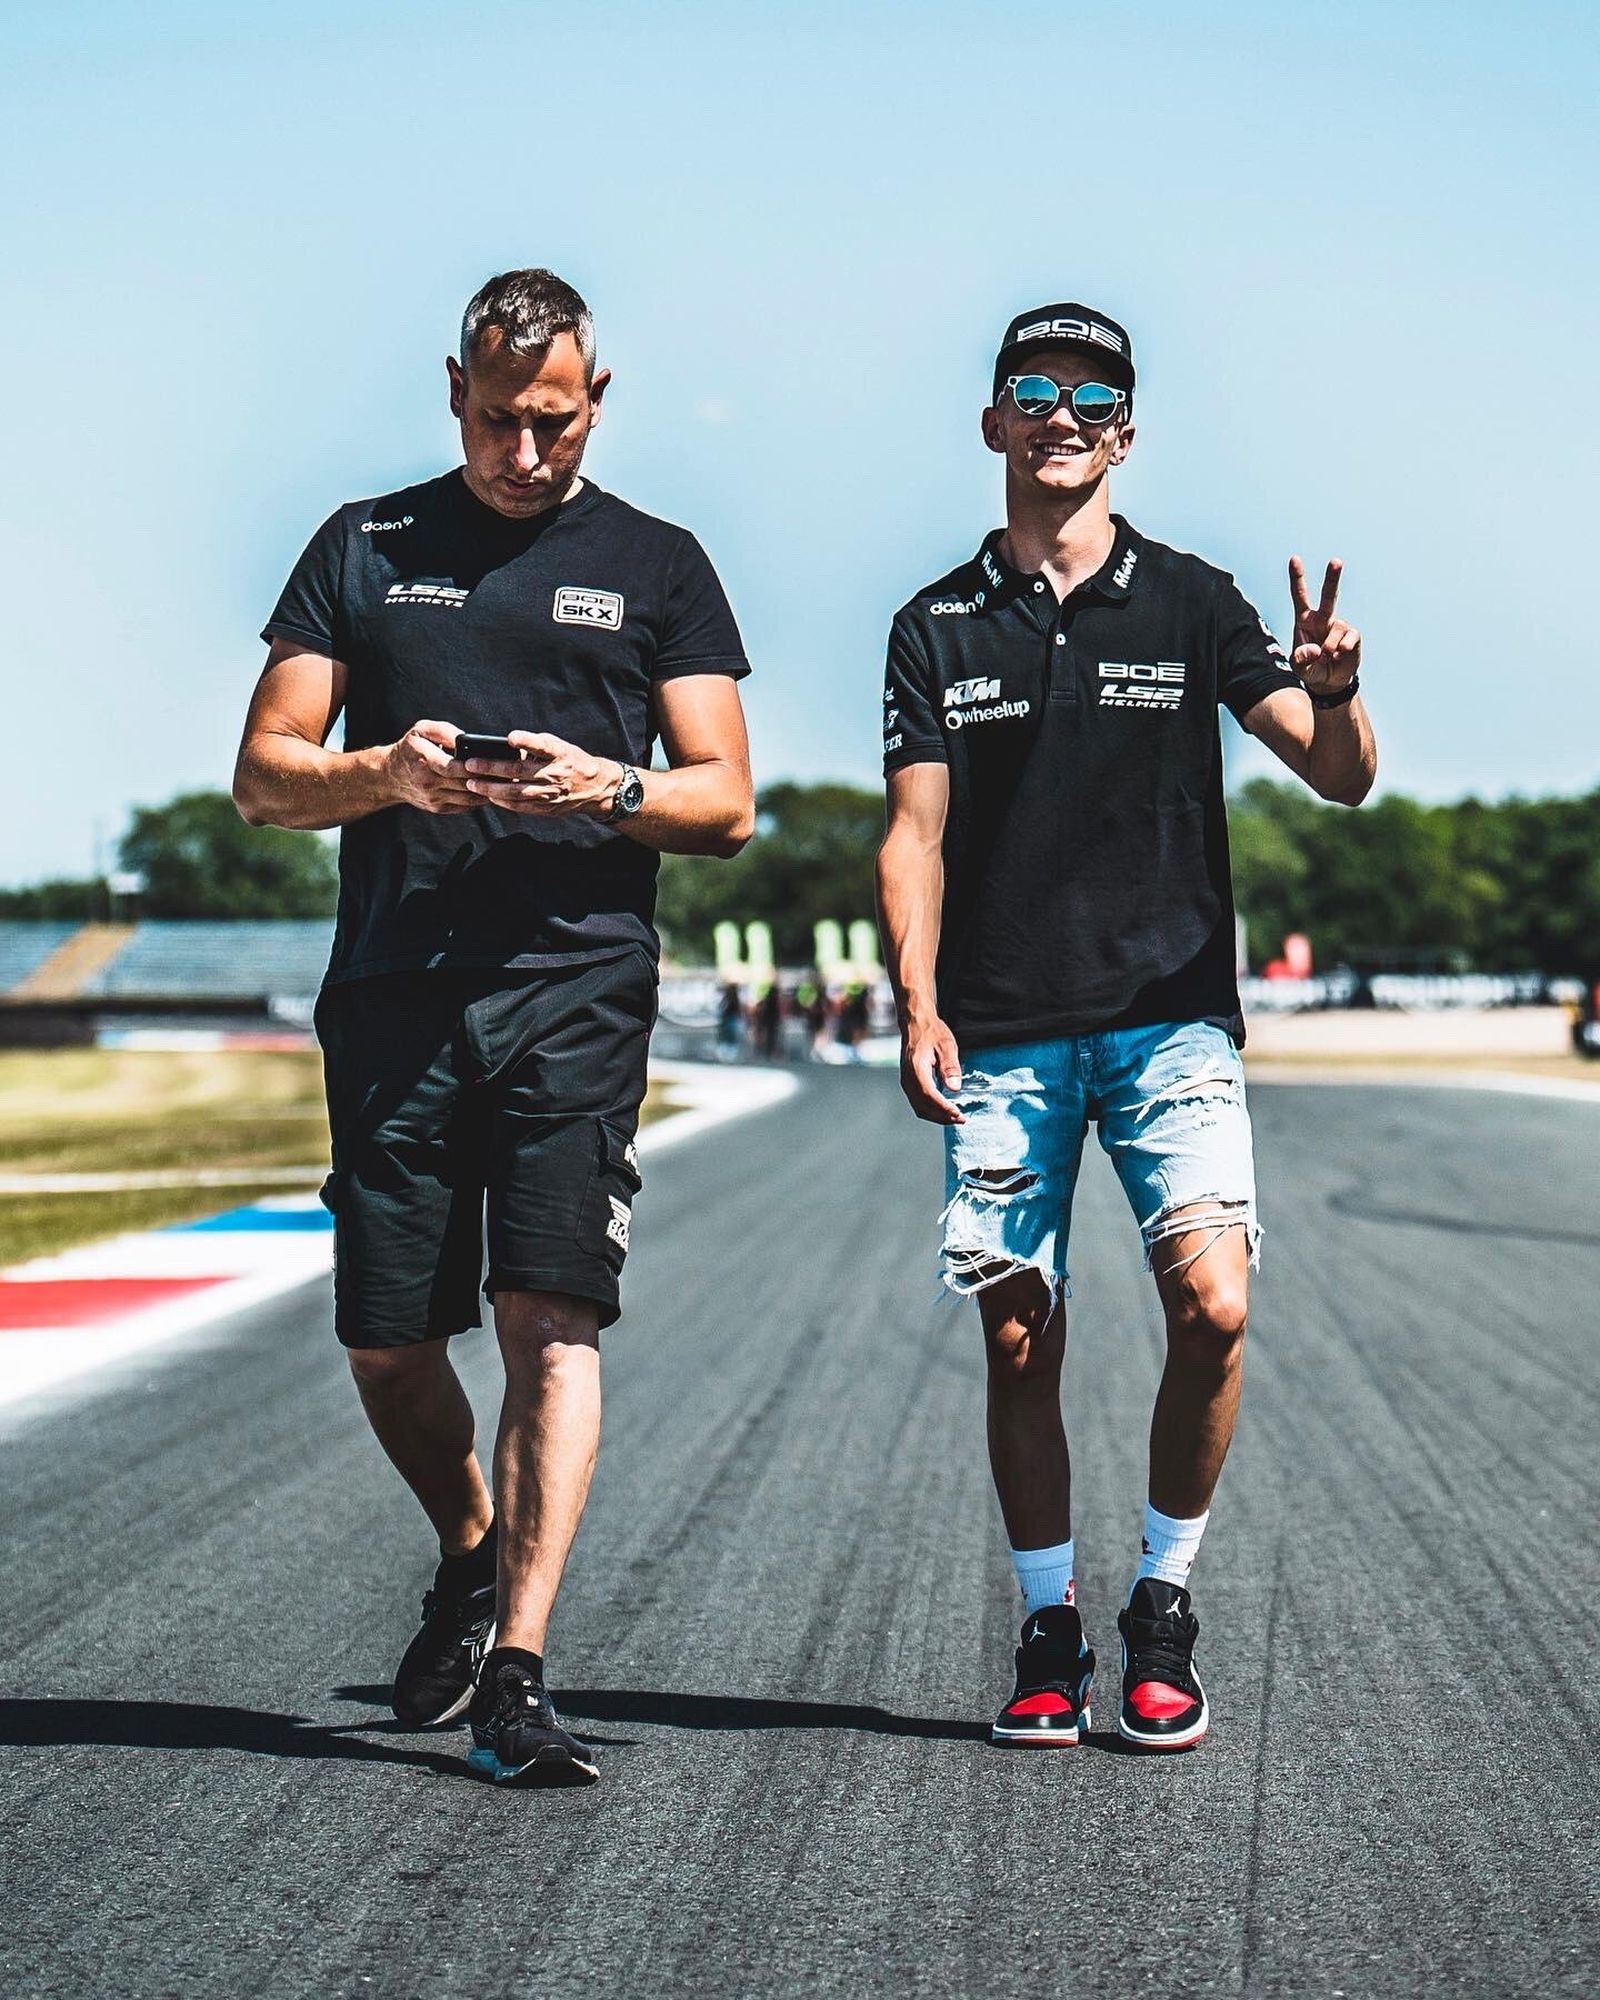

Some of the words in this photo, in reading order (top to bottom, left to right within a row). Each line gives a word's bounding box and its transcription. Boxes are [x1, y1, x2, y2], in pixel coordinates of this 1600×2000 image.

[1017, 319, 1122, 352] BOE
[387, 584, 469, 600] LS2
[1098, 662, 1186, 682] BOE
[943, 676, 1001, 707] KTM
[1099, 684, 1184, 701] LS2
[1099, 699, 1181, 710] HELMETS
